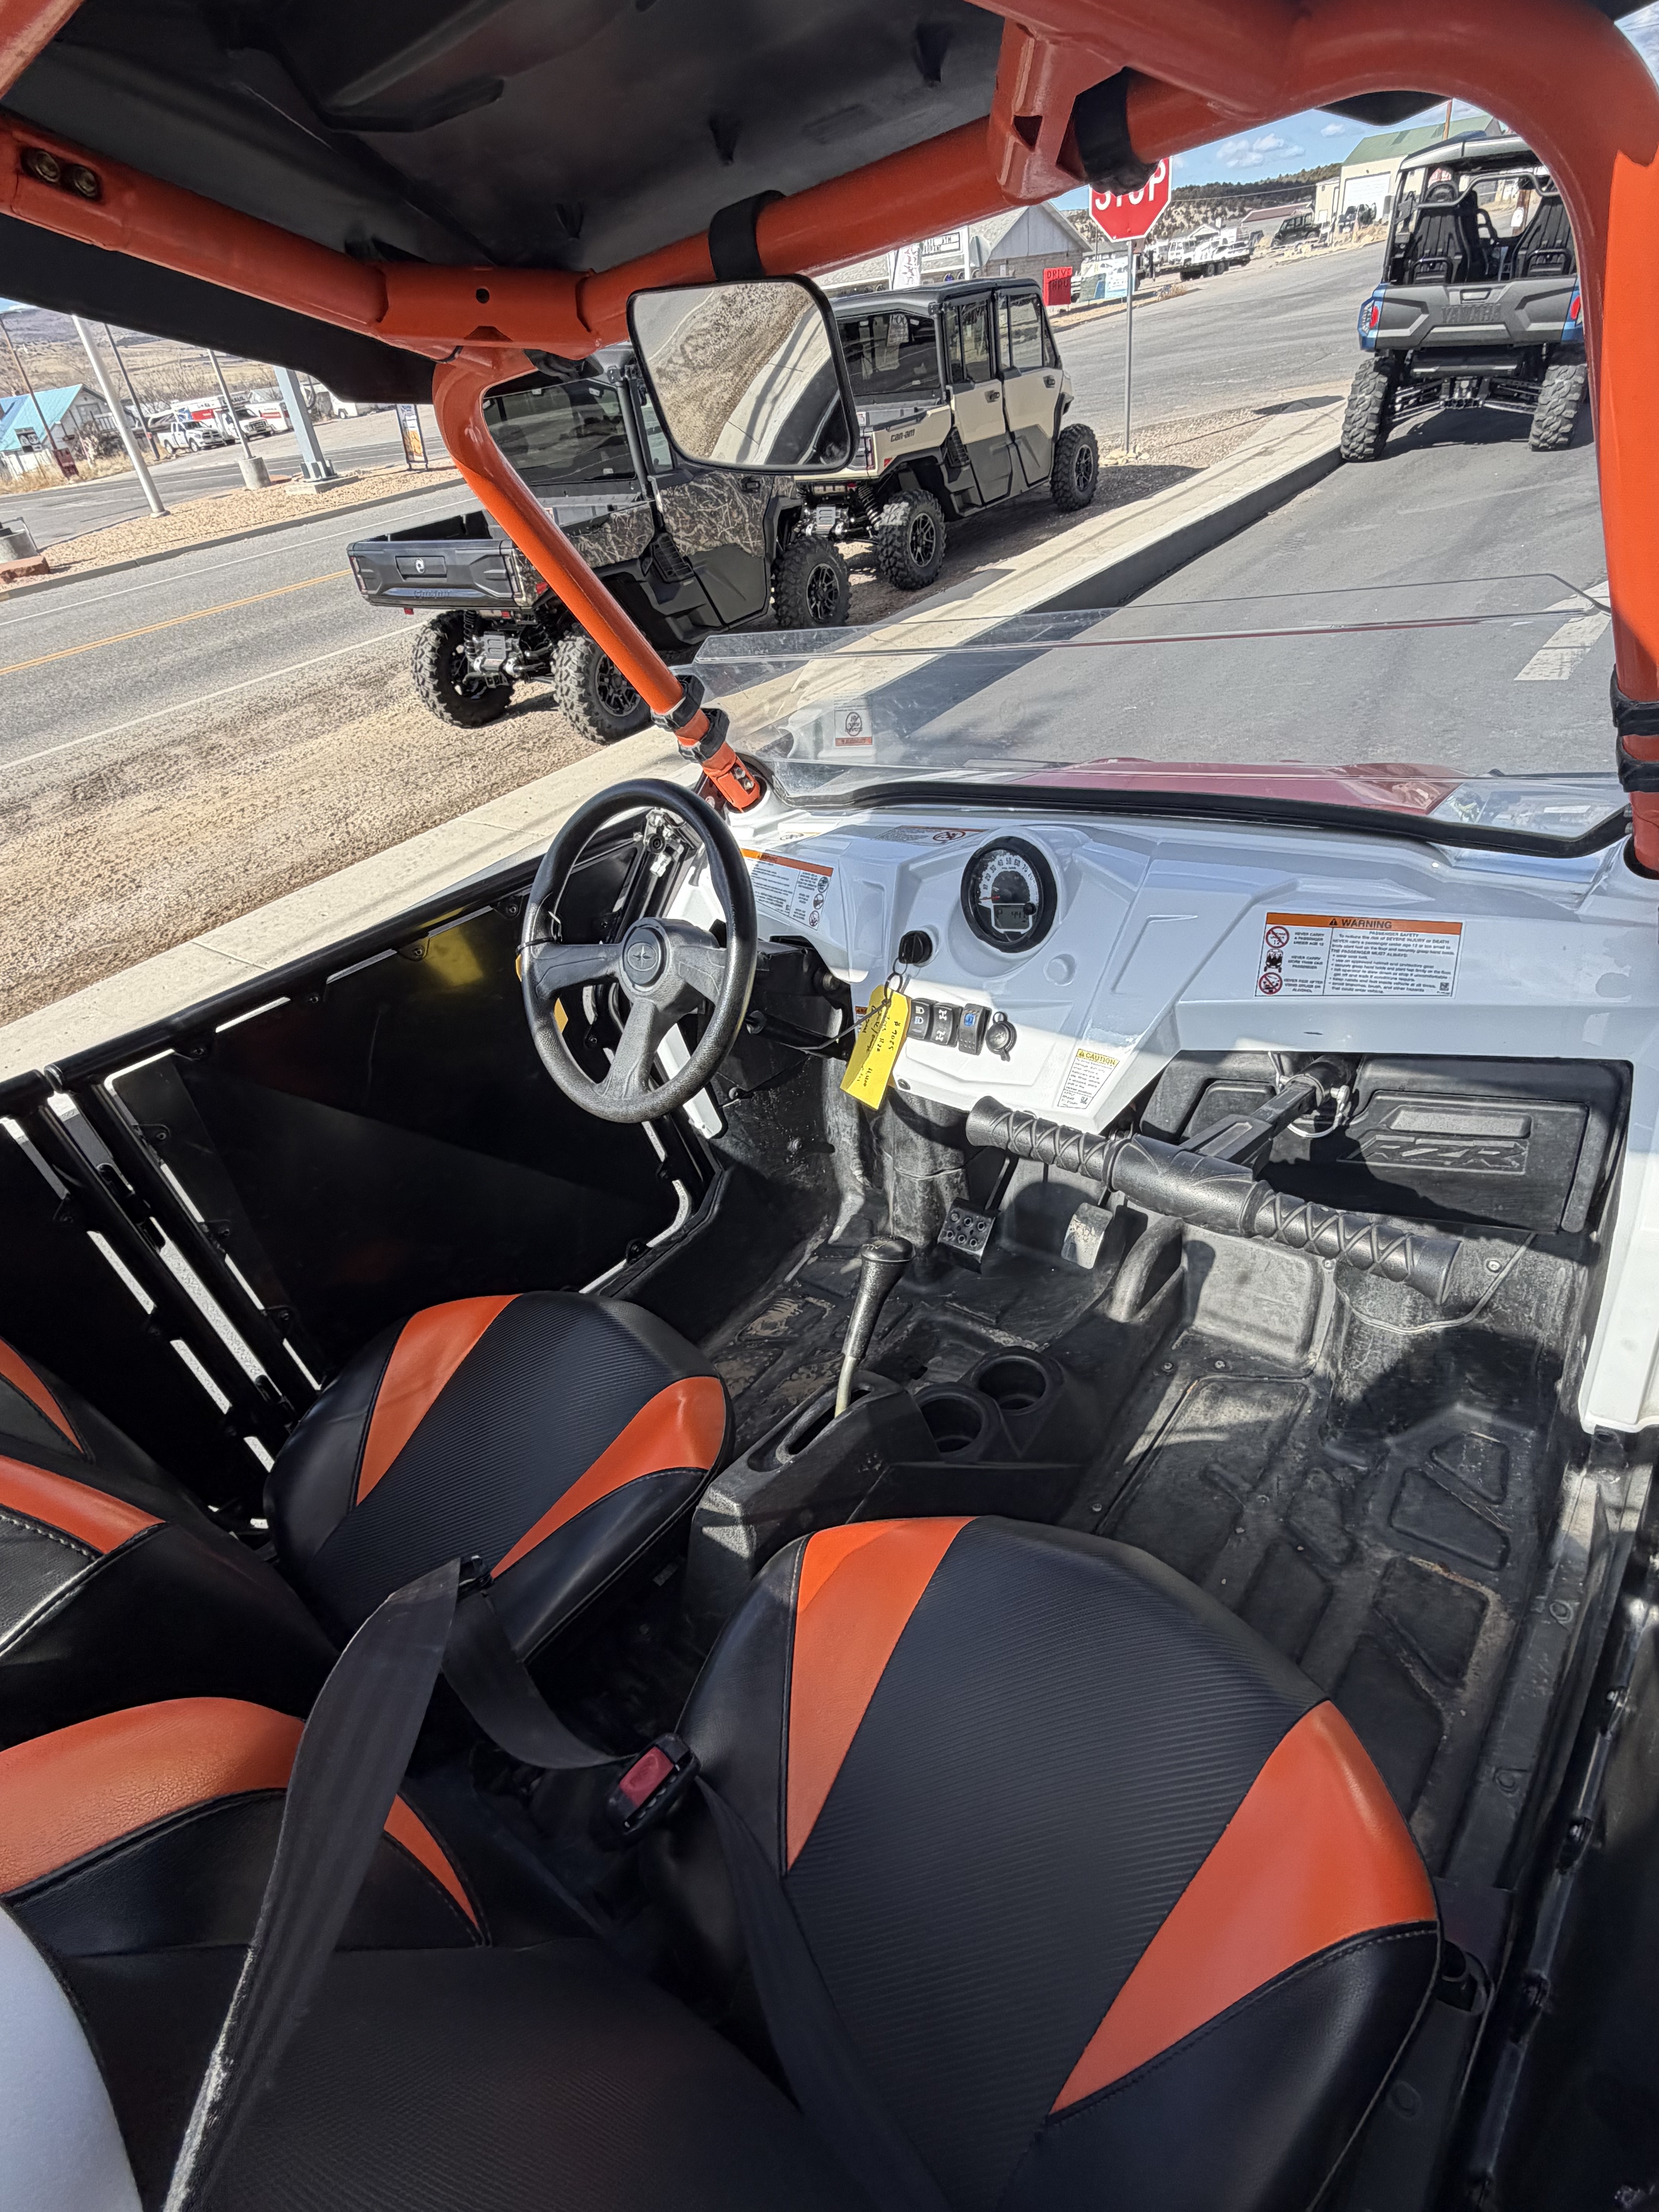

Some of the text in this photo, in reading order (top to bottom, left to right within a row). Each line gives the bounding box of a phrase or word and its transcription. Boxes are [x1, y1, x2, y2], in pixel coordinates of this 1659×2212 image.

[1047, 268, 1072, 279] DRIVE
[1442, 304, 1501, 323] YAMAHA
[890, 428, 915, 442] can-am
[1022, 864, 1029, 872] 70
[1341, 918, 1392, 929] WARNING
[1085, 1052, 1116, 1065] CAUTION
